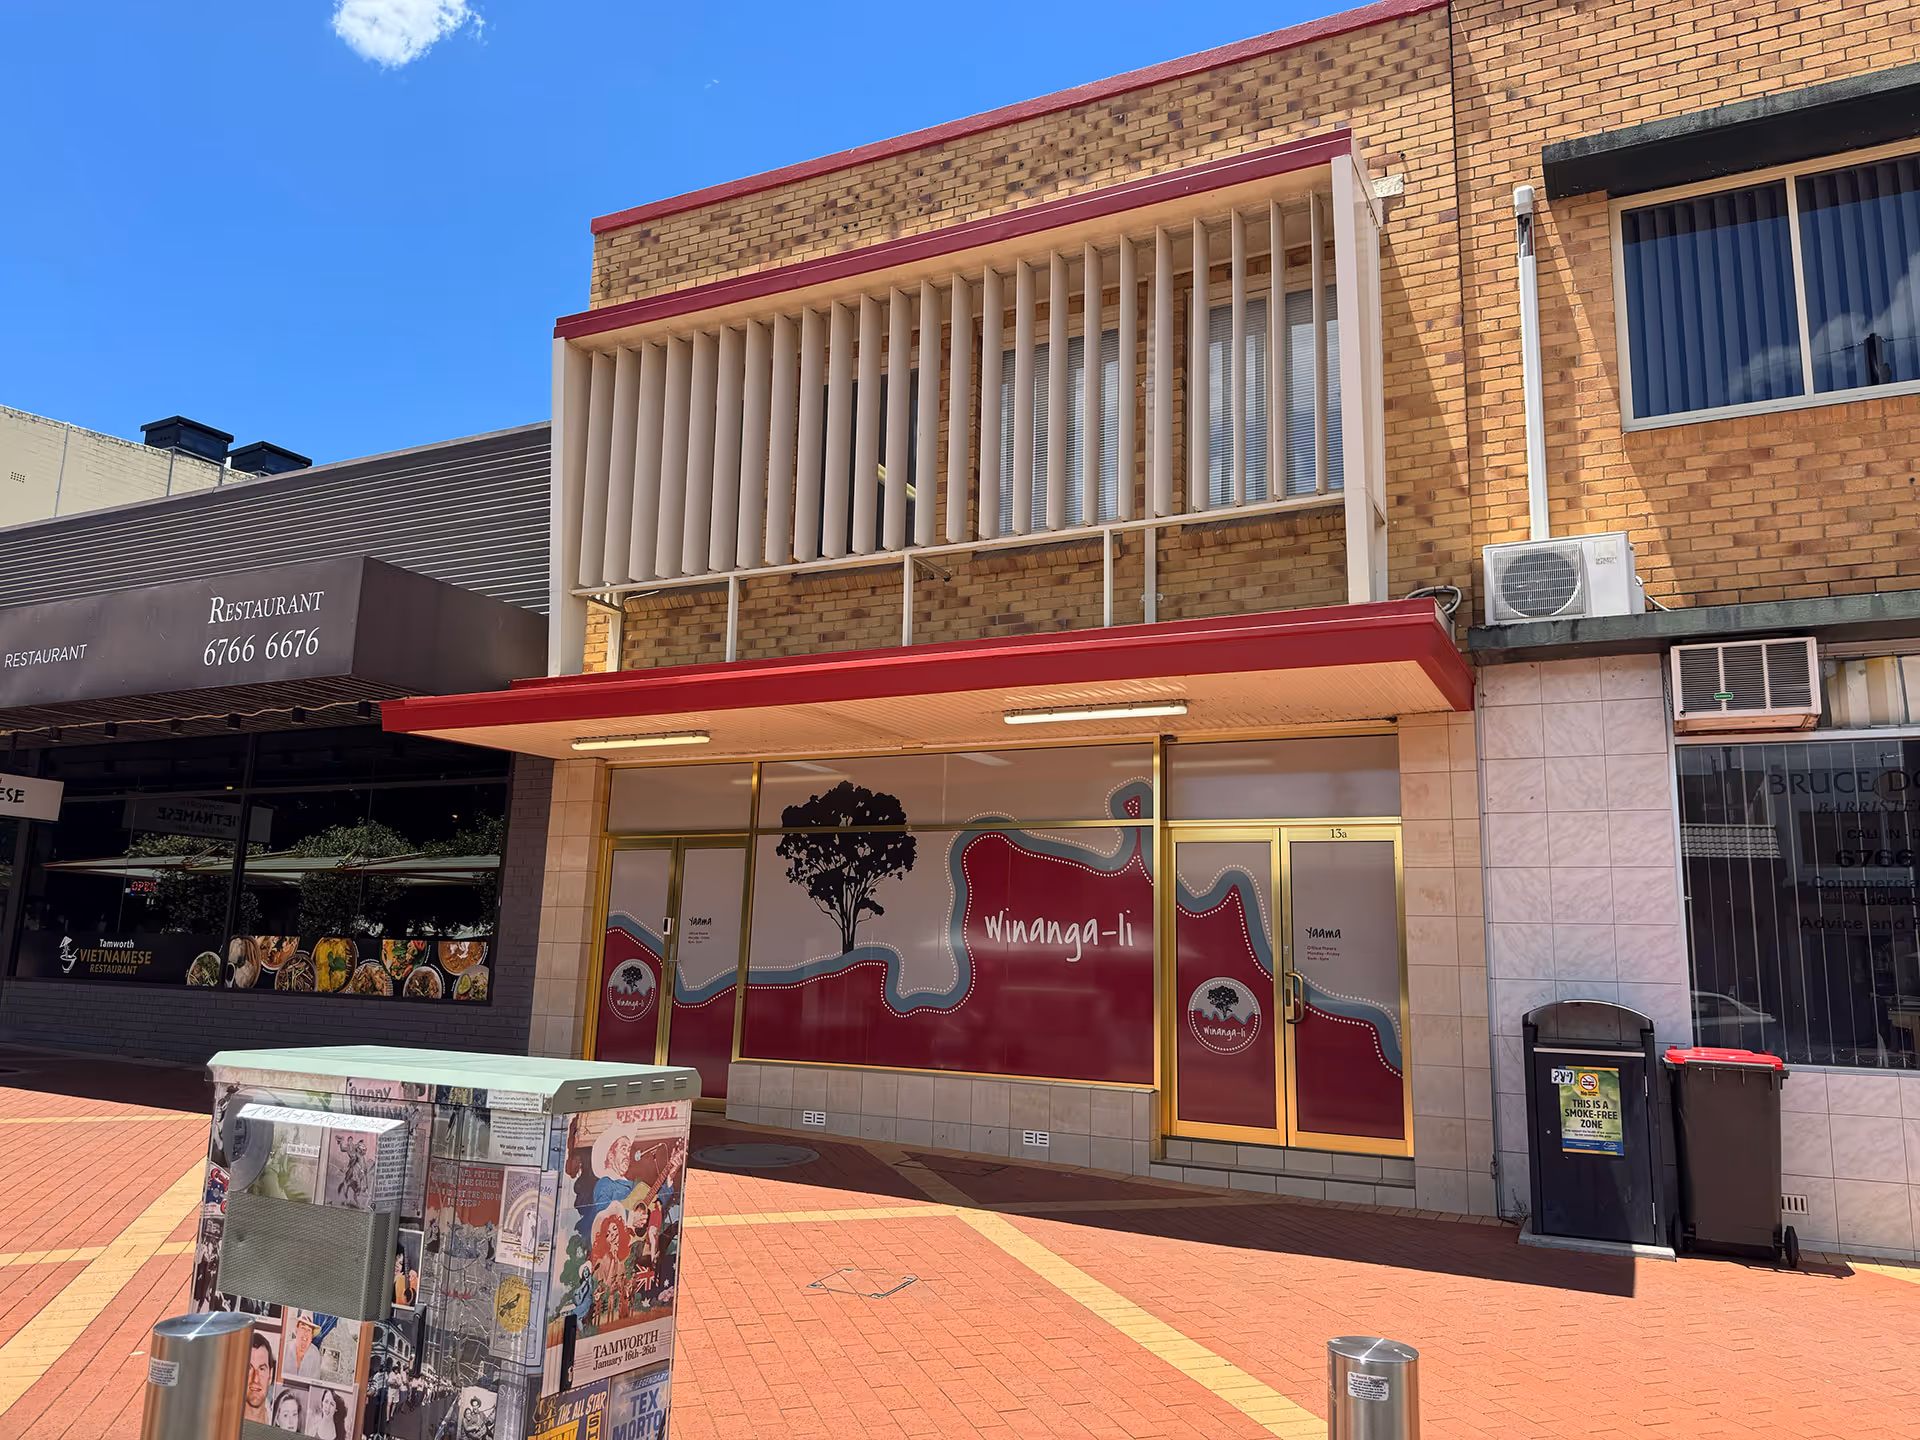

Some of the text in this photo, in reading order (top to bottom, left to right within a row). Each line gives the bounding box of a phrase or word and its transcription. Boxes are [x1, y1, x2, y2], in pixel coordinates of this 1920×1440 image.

[203, 627, 319, 666] 6766 6676
[4, 644, 88, 668] RESTAURANT
[1768, 771, 1874, 795] BRUCE
[1330, 828, 1348, 839] 13a
[984, 908, 1134, 963] Winanga-li
[1305, 927, 1342, 939] Yaama
[99, 938, 135, 949] Tamworth
[80, 948, 153, 965] VIETNAMESE
[89, 963, 138, 975] RESTAURANT
[1203, 1025, 1246, 1041] Winanga-li
[1572, 1099, 1609, 1110] THIS IS A
[616, 1106, 679, 1123] FESTIVAL
[1564, 1109, 1618, 1120] SMOKE-FREE
[1580, 1119, 1603, 1129] ZONE
[593, 1328, 660, 1360] TAMWORTH
[593, 1344, 657, 1371] January 16th-26th
[571, 1398, 586, 1420] ALL
[585, 1390, 608, 1416] STAR
[630, 1386, 660, 1418] TEX
[612, 1408, 664, 1440] MORTO
